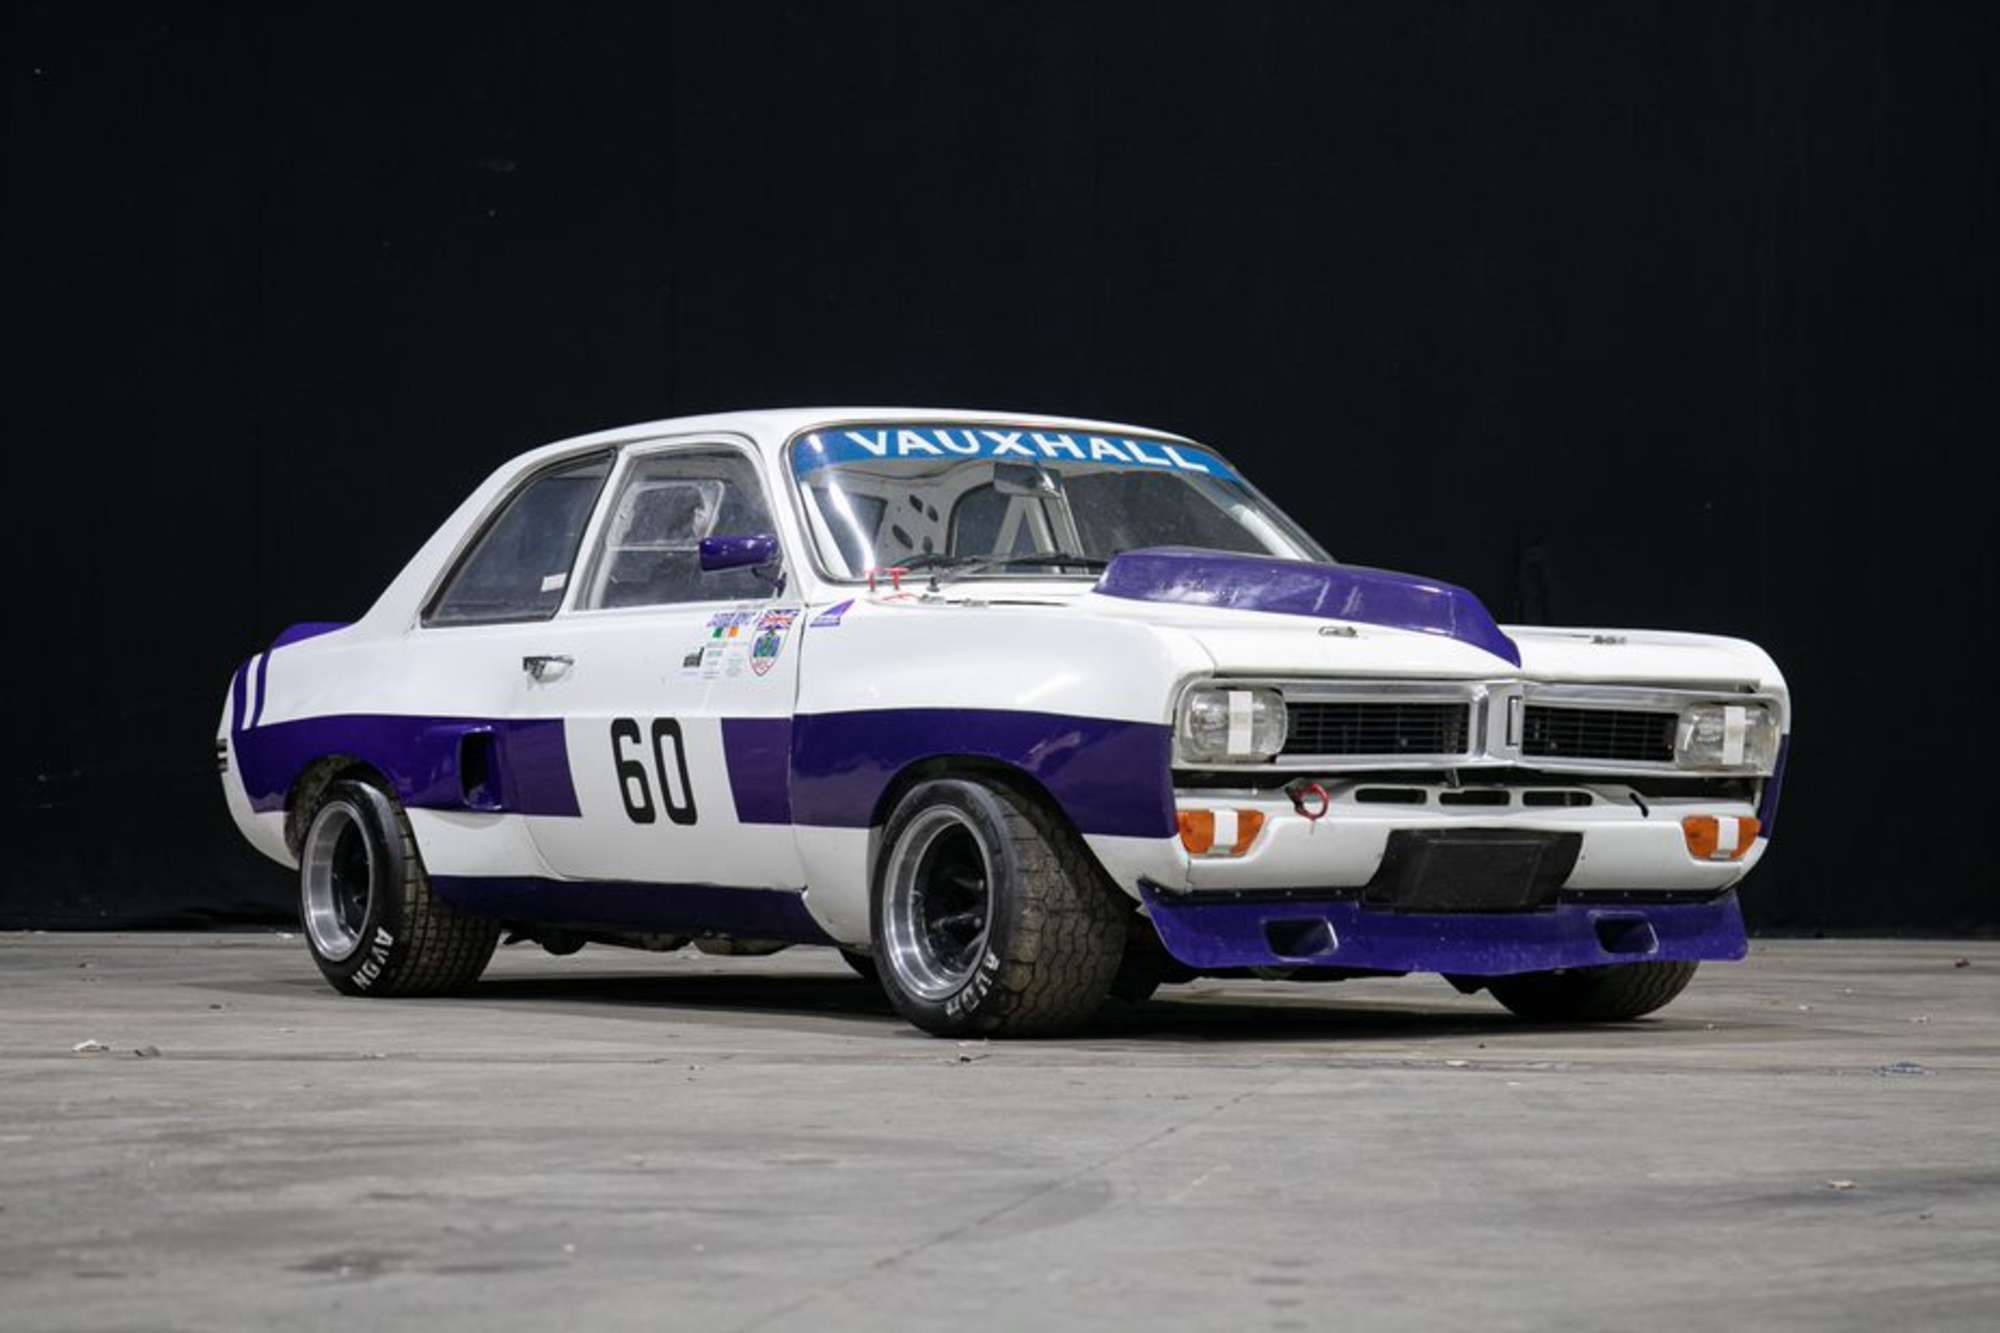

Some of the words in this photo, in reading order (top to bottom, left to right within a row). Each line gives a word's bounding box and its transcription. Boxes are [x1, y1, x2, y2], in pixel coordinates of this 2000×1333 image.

[845, 430, 1210, 473] VAUXHALL
[611, 717, 698, 826] 60
[352, 926, 394, 990] AVON
